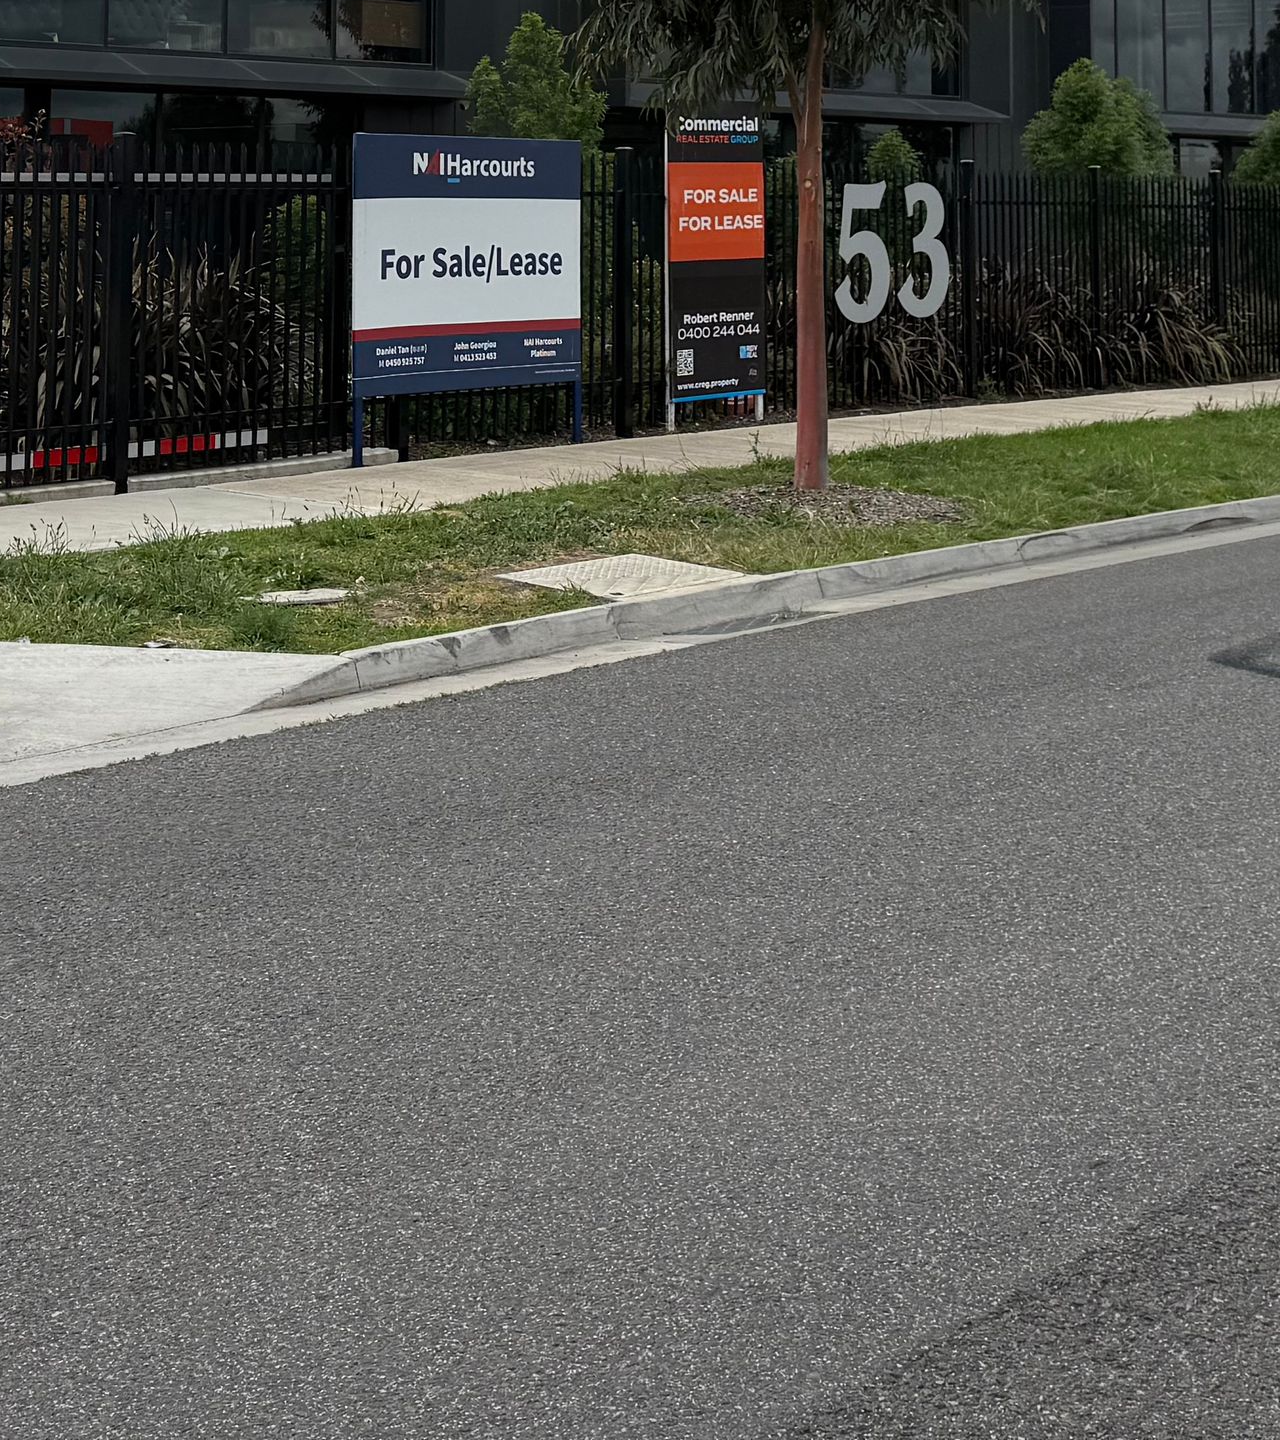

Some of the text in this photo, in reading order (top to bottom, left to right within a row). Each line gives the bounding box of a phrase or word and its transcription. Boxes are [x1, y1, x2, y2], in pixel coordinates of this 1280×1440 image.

[676, 135, 759, 144] REAL ESTATE GROUP
[447, 153, 536, 178] Harcourts
[683, 188, 758, 204] FOR SALE
[678, 214, 764, 232] FOR LEASE
[834, 180, 950, 324] 53
[380, 244, 563, 284] For Sale/Lease
[683, 311, 755, 325] Robert Renner
[677, 323, 760, 340] 0400 244 044
[453, 340, 497, 351] John Georgiou
[524, 337, 563, 346] NAI Harcourts
[376, 346, 397, 356] Daniel
[397, 345, 410, 355] Tan
[530, 349, 557, 358] Platinum
[385, 358, 401, 368] 0450
[413, 356, 425, 365] 757
[677, 378, 739, 391] www.creg.property
